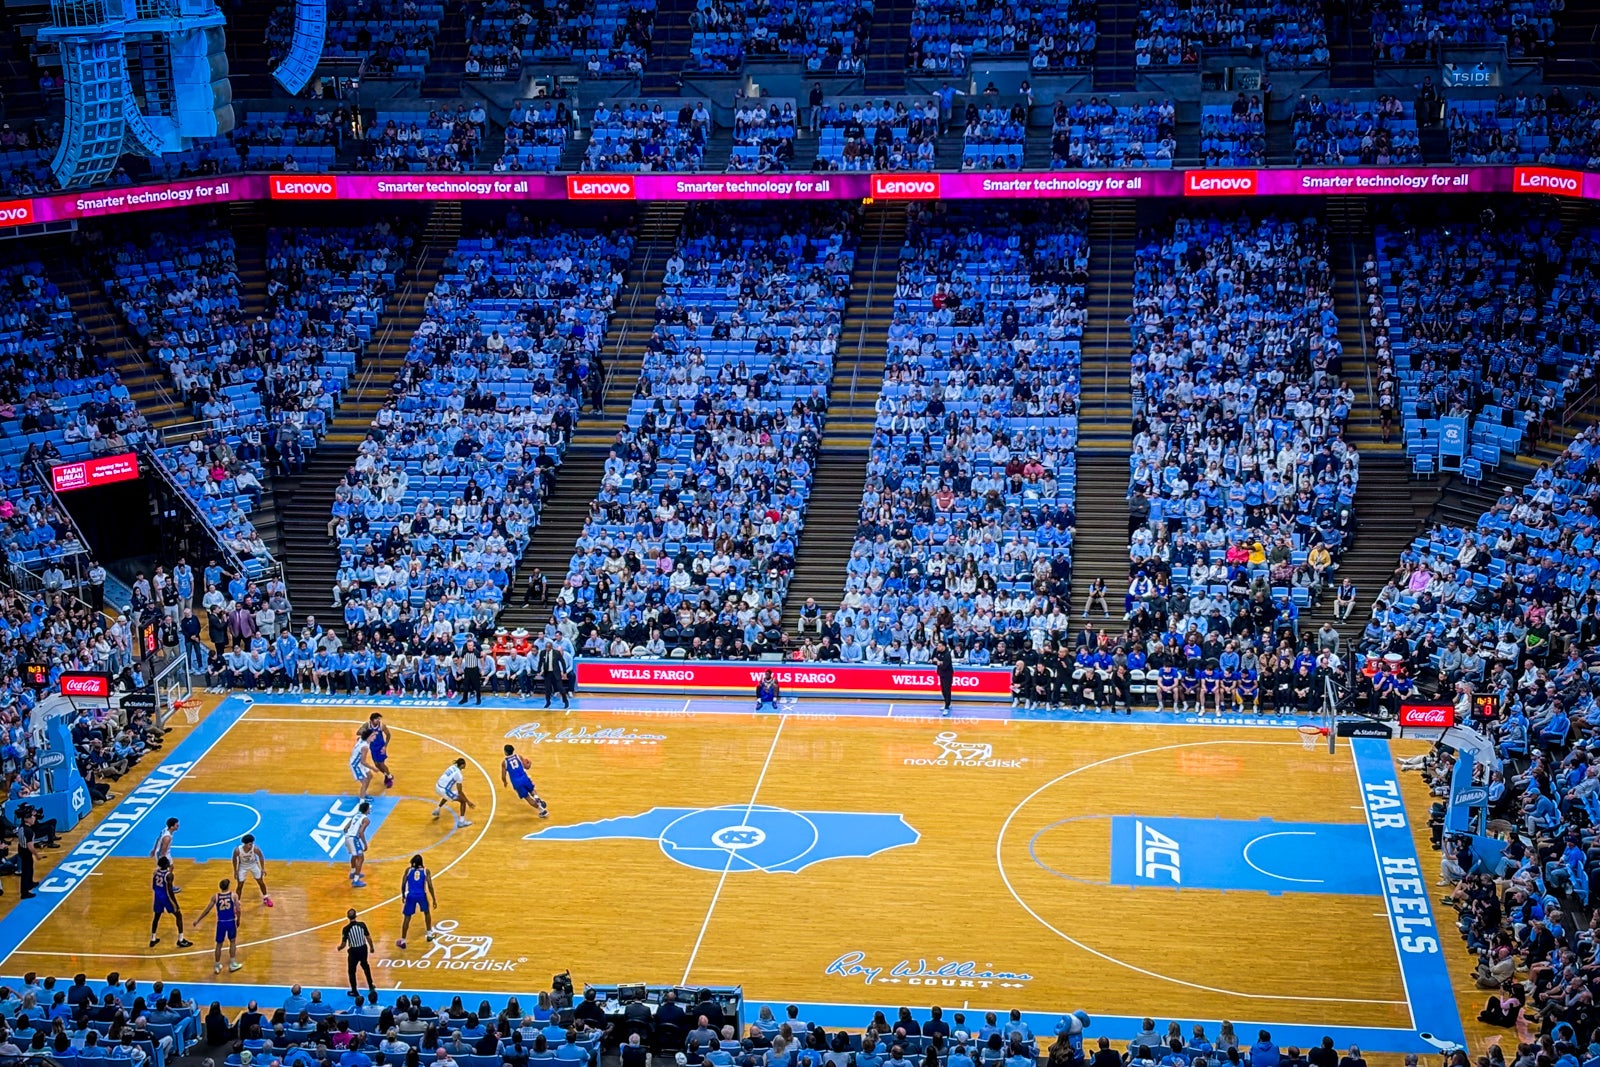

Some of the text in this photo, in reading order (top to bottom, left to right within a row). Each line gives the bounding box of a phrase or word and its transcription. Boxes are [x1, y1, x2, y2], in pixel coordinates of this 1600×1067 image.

[276, 180, 332, 194] Lenovo
[377, 181, 528, 194] Smarter technology for all
[573, 180, 630, 194] Lenovo
[676, 180, 830, 194] Smarter technology for all
[876, 179, 935, 194] Lenovo
[983, 177, 1141, 191] Smarter technology for all
[1191, 176, 1252, 190] Lenovo
[1302, 174, 1469, 188] Smarter technology for all
[1520, 173, 1577, 190] Lenovo
[77, 182, 229, 210] Smarter technology for all
[56, 472, 84, 483] BUREAU
[63, 466, 83, 475] FARM
[609, 669, 695, 681] WELLS FARGO
[749, 671, 836, 684] WLS FARGO
[891, 674, 980, 687] WELLS RGO
[66, 679, 100, 692] Coca-Cola
[1405, 709, 1446, 723] Coca-Cola
[504, 722, 668, 745] Roy Williams
[567, 738, 630, 746] COURT
[903, 758, 949, 767] novo
[1454, 791, 1484, 805] LIBMAN
[38, 760, 194, 893] CAROLINA
[309, 798, 362, 853] ACC
[1144, 824, 1181, 885] ACC
[1365, 779, 1439, 955] TAR HEELS
[219, 899, 231, 911] 25
[376, 957, 432, 970] novo
[824, 951, 1034, 984] Roy Williams
[907, 977, 994, 989] COURT
